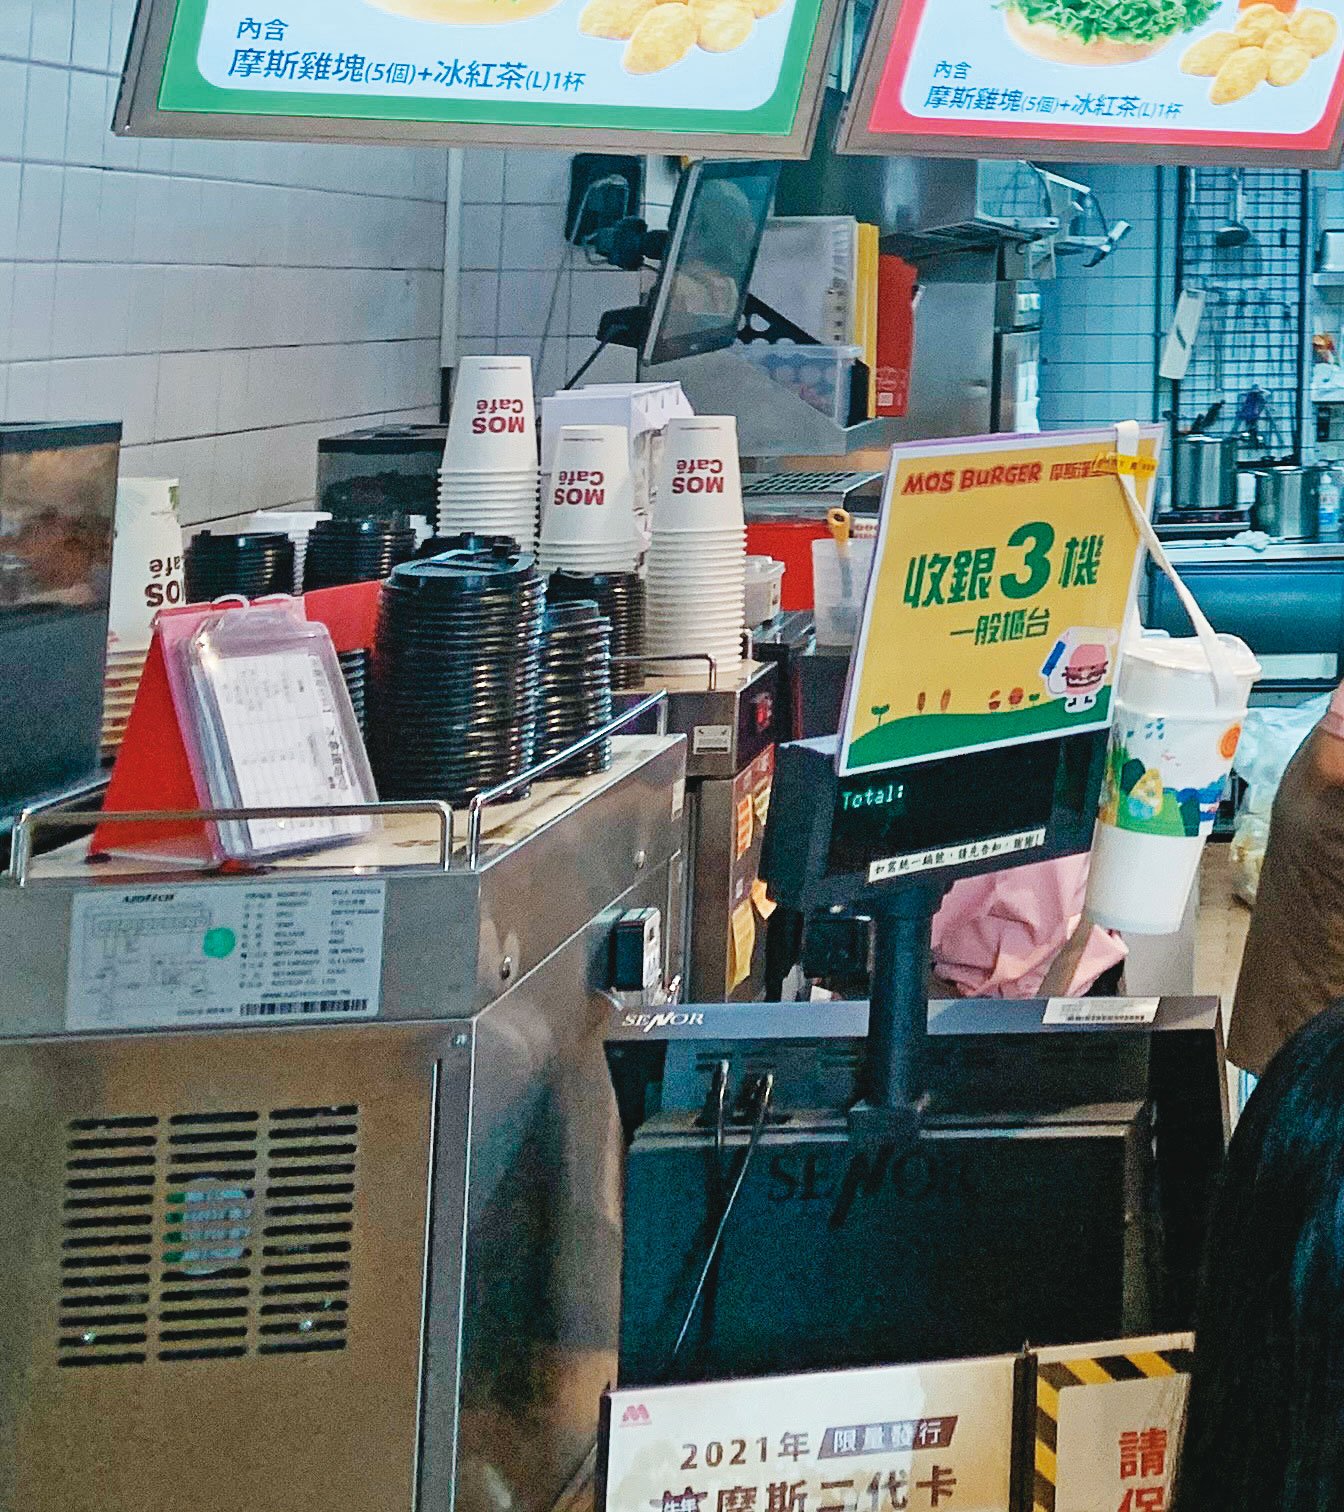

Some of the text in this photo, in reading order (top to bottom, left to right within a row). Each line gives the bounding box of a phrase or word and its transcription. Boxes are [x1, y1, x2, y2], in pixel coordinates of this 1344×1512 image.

[476, 399, 524, 413] Café
[471, 416, 526, 434] MOS
[558, 470, 605, 486] Café
[676, 459, 724, 475] Café
[901, 460, 1042, 496] MOS BURGER
[553, 488, 605, 505] MOS
[671, 476, 725, 494] MOS
[148, 556, 184, 579] afé
[903, 521, 1105, 610] 收銀3機
[144, 580, 184, 608] OS
[949, 606, 1051, 647] 一般櫃台
[840, 784, 905, 812] Total:
[620, 1008, 705, 1034] SENOR
[680, 1429, 811, 1471] 2021年
[831, 1419, 945, 1455] 限量發行
